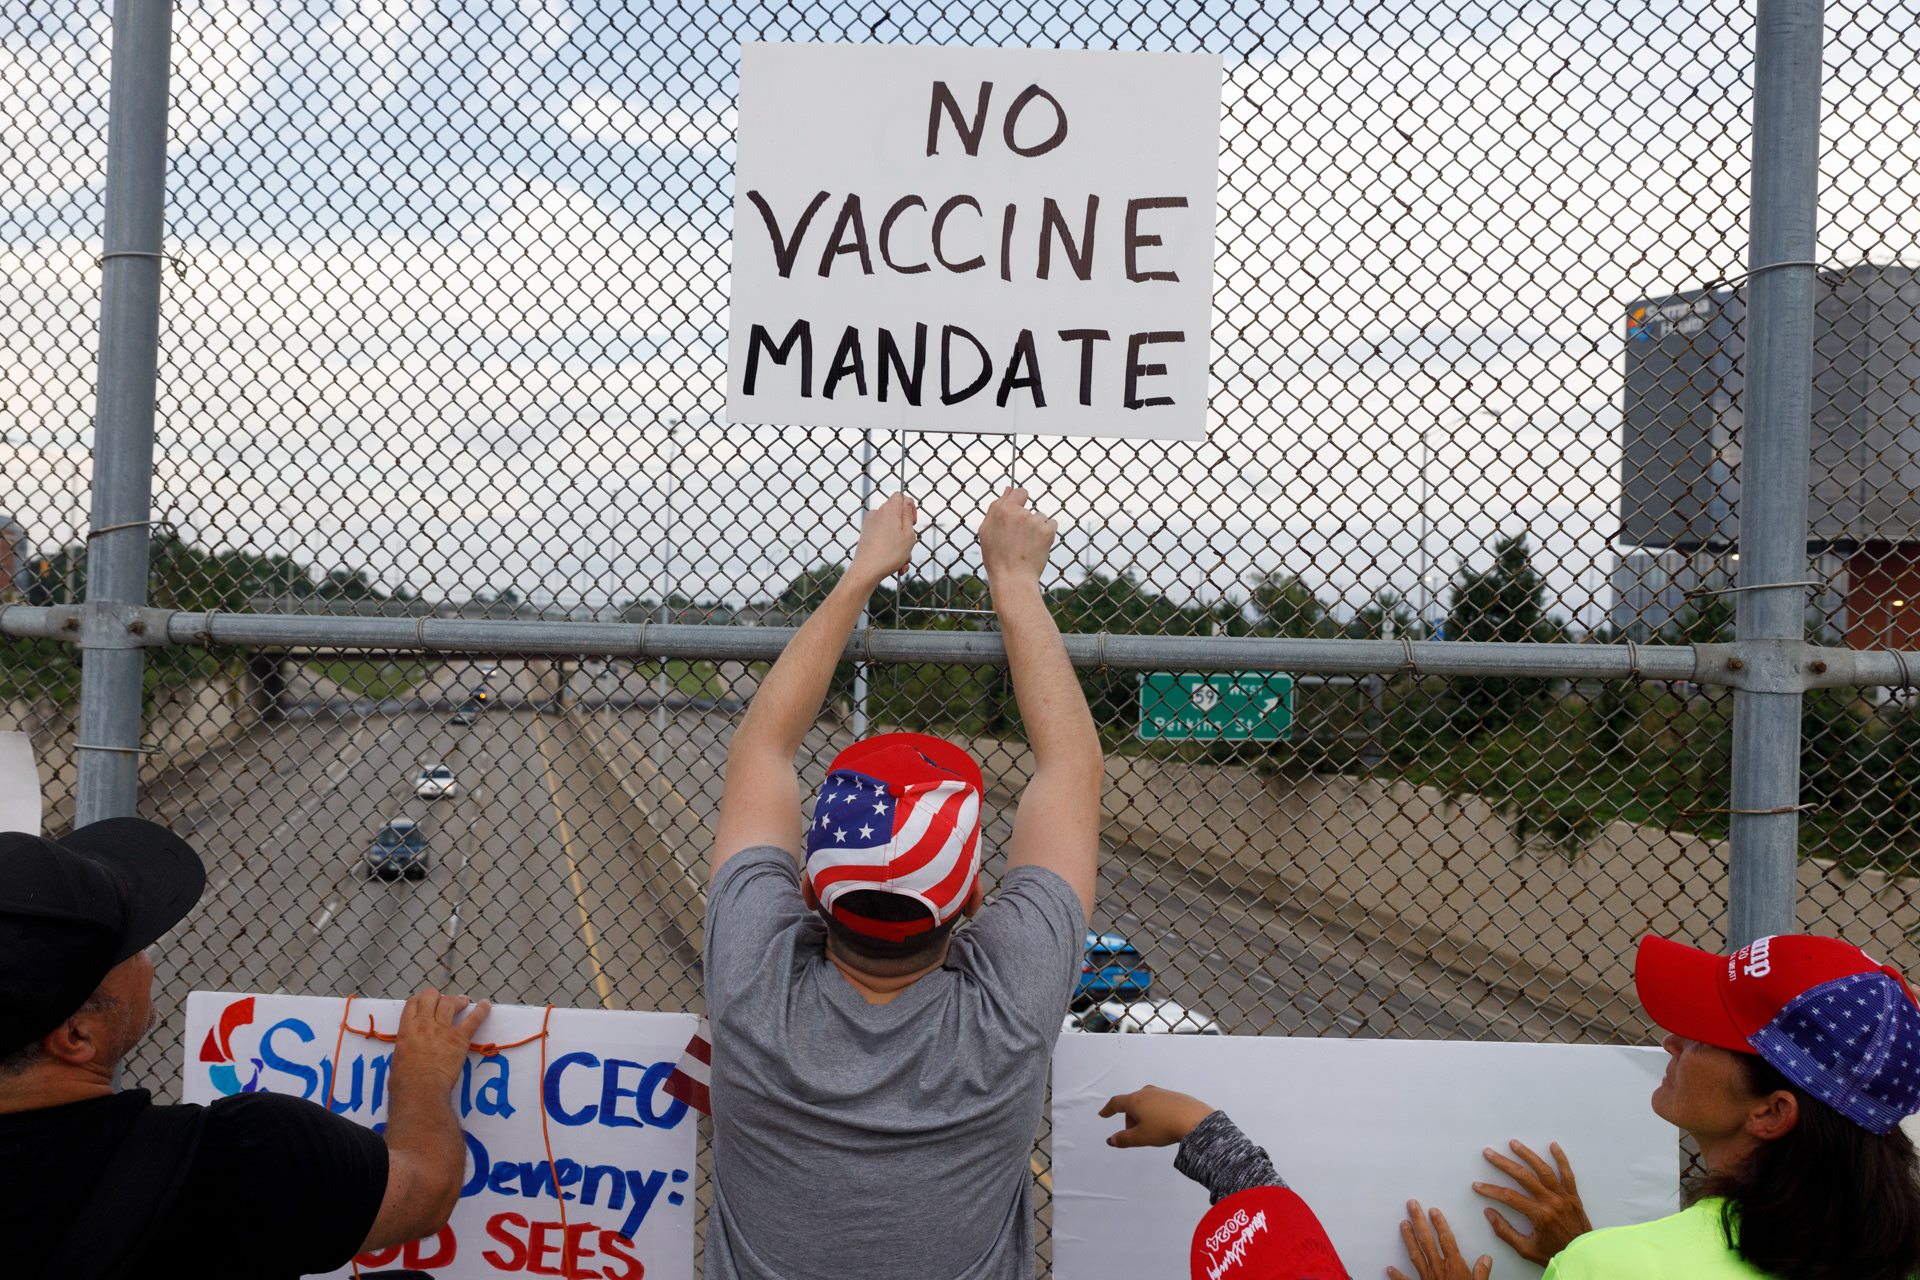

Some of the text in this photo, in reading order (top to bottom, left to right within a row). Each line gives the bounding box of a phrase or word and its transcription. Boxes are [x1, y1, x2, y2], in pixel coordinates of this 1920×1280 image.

[926, 81, 1068, 157] NO
[746, 190, 1189, 283] VACCINE
[743, 318, 1186, 410] MANDATE
[1154, 717, 1254, 732] Perkins St
[259, 1017, 690, 1130] Sua CEO
[481, 1211, 645, 1280] SEES
[1206, 1208, 1250, 1252] 2024
